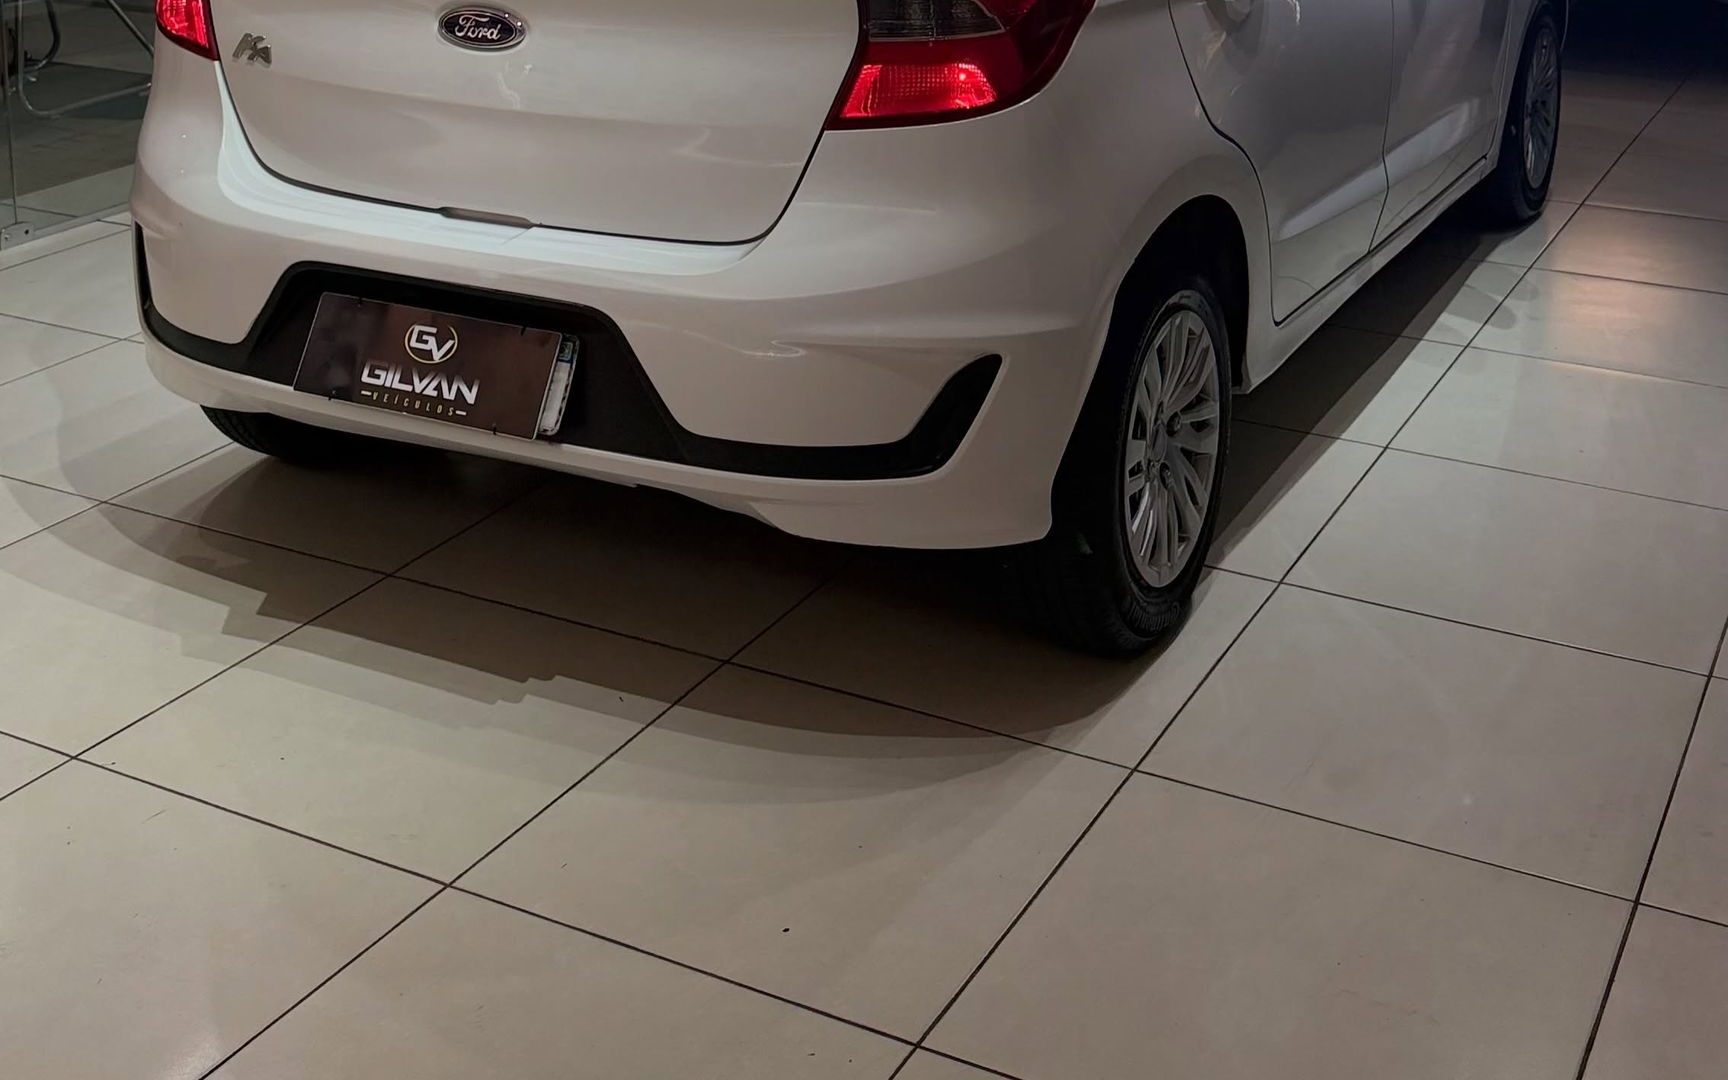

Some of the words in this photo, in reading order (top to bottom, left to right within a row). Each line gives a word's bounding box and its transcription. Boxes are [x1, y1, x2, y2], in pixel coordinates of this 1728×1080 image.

[455, 14, 503, 40] Ford
[409, 324, 455, 361] GV
[361, 360, 480, 405] GILVAN
